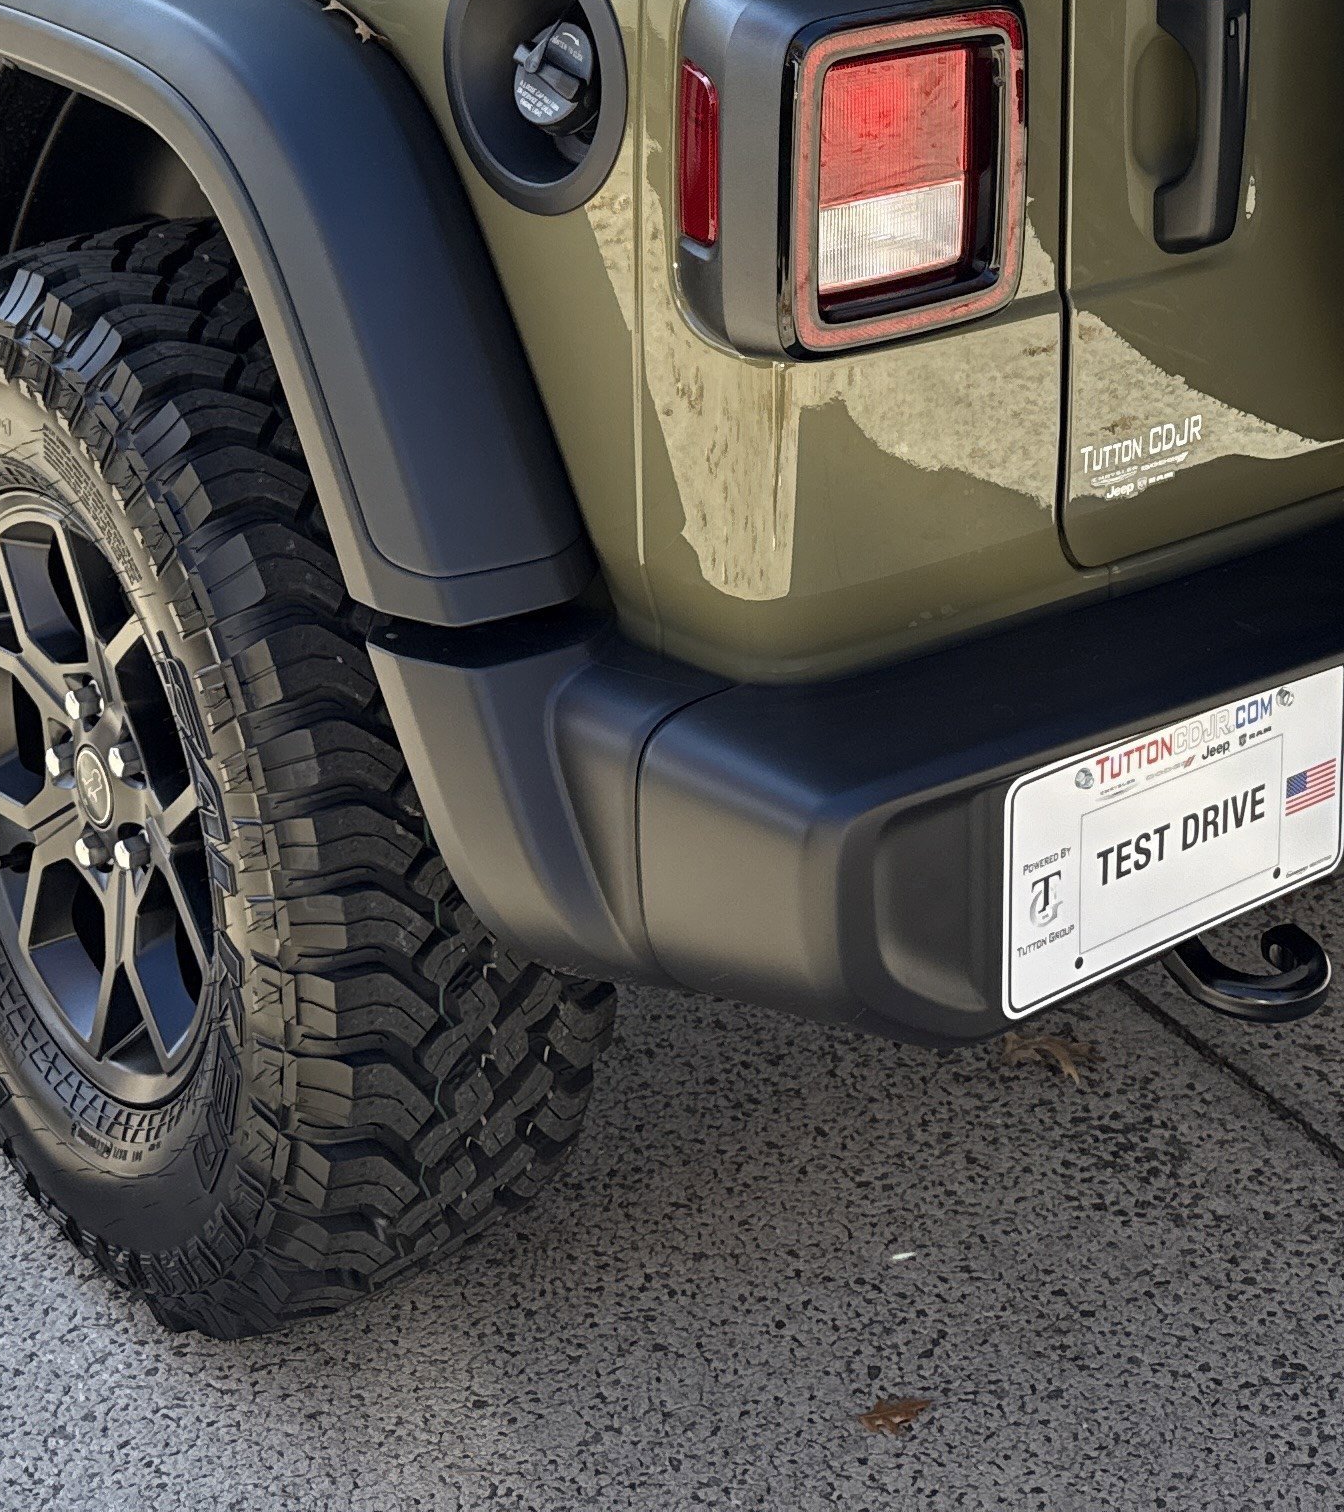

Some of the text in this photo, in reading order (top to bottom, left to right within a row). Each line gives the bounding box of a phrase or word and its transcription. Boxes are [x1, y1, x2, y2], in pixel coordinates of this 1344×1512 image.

[1080, 414, 1202, 474] TUTTON CDJR
[1106, 482, 1135, 499] Jeep
[1201, 740, 1231, 761] Jeep
[1096, 783, 1266, 887] TEST DRIVE
[1022, 846, 1072, 876] POWERED BY
[1016, 924, 1075, 958] TUTTON GROUP
